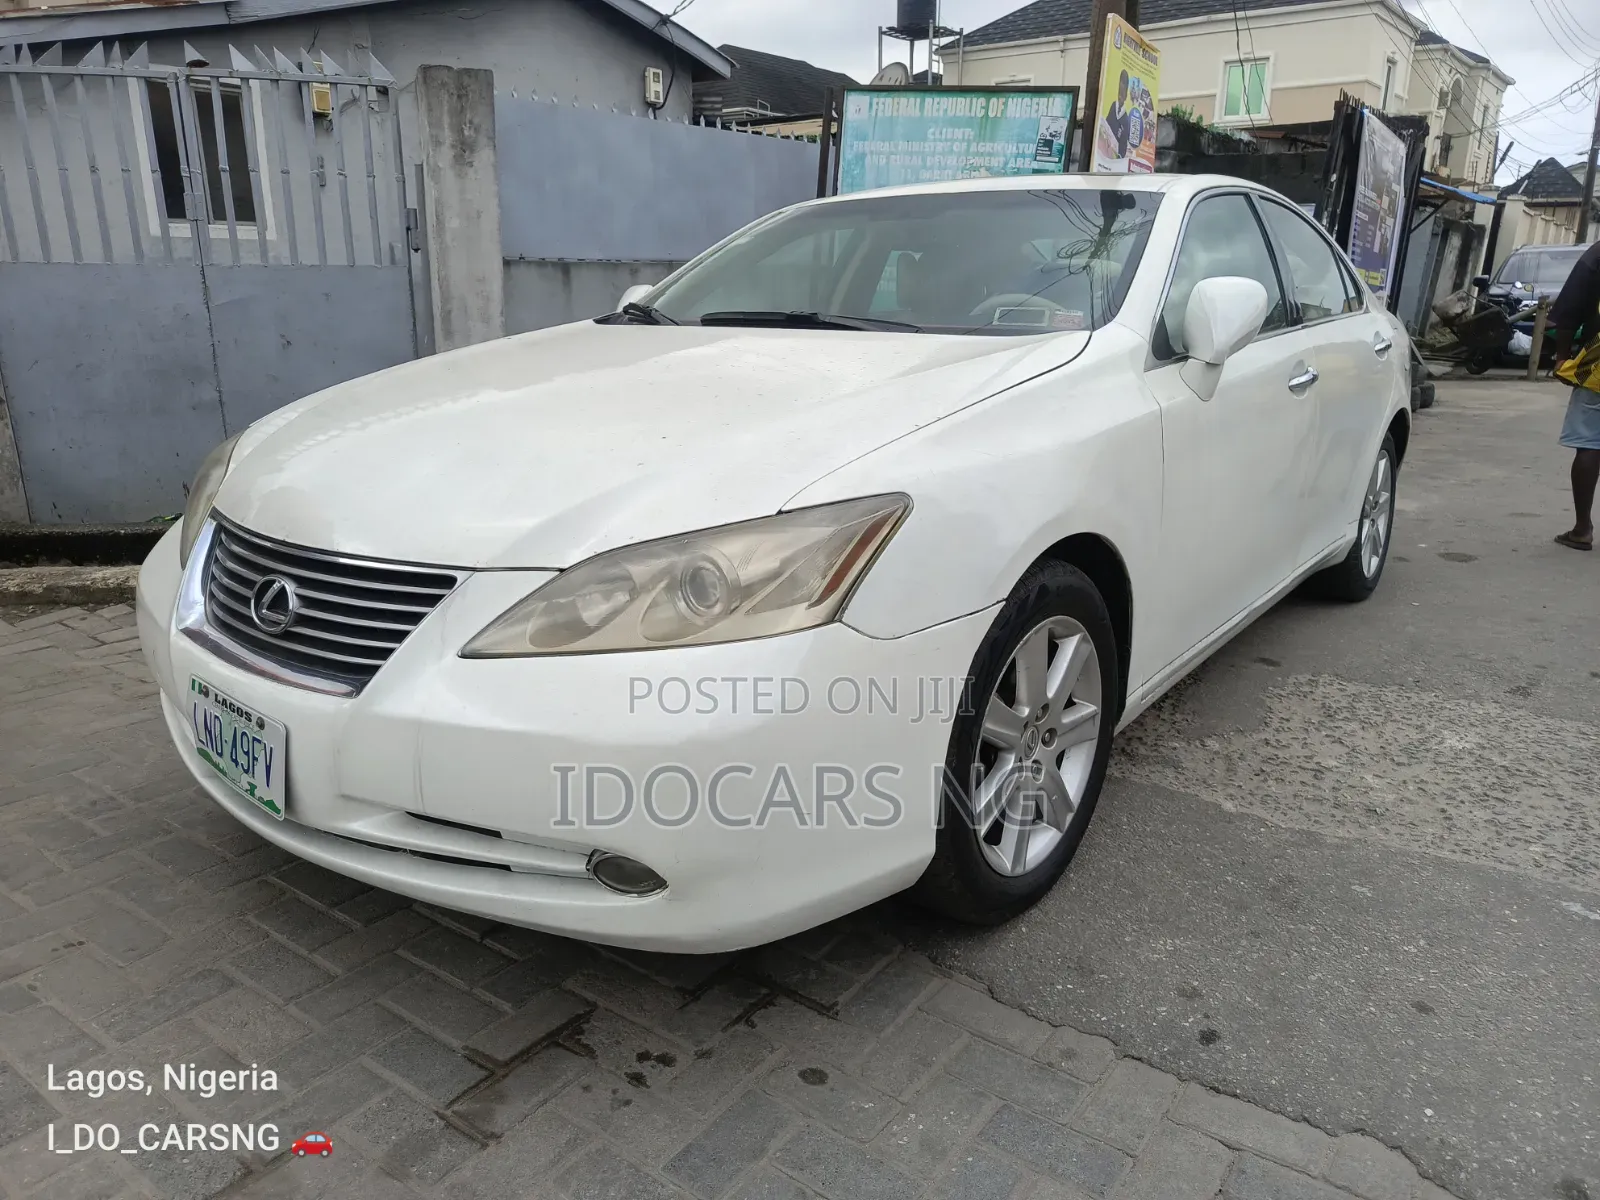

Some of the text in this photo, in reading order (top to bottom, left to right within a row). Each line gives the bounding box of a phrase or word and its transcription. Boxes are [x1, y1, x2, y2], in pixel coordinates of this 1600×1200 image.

[872, 97, 921, 117] FEDERAL
[923, 97, 987, 117] REPUBLIC
[988, 97, 1005, 118] OF
[897, 141, 951, 153] MINISTRY
[952, 142, 968, 153] OF
[865, 154, 887, 166] AND
[925, 155, 1006, 168] DEVELOPMENT
[214, 693, 252, 722] LAGOS
